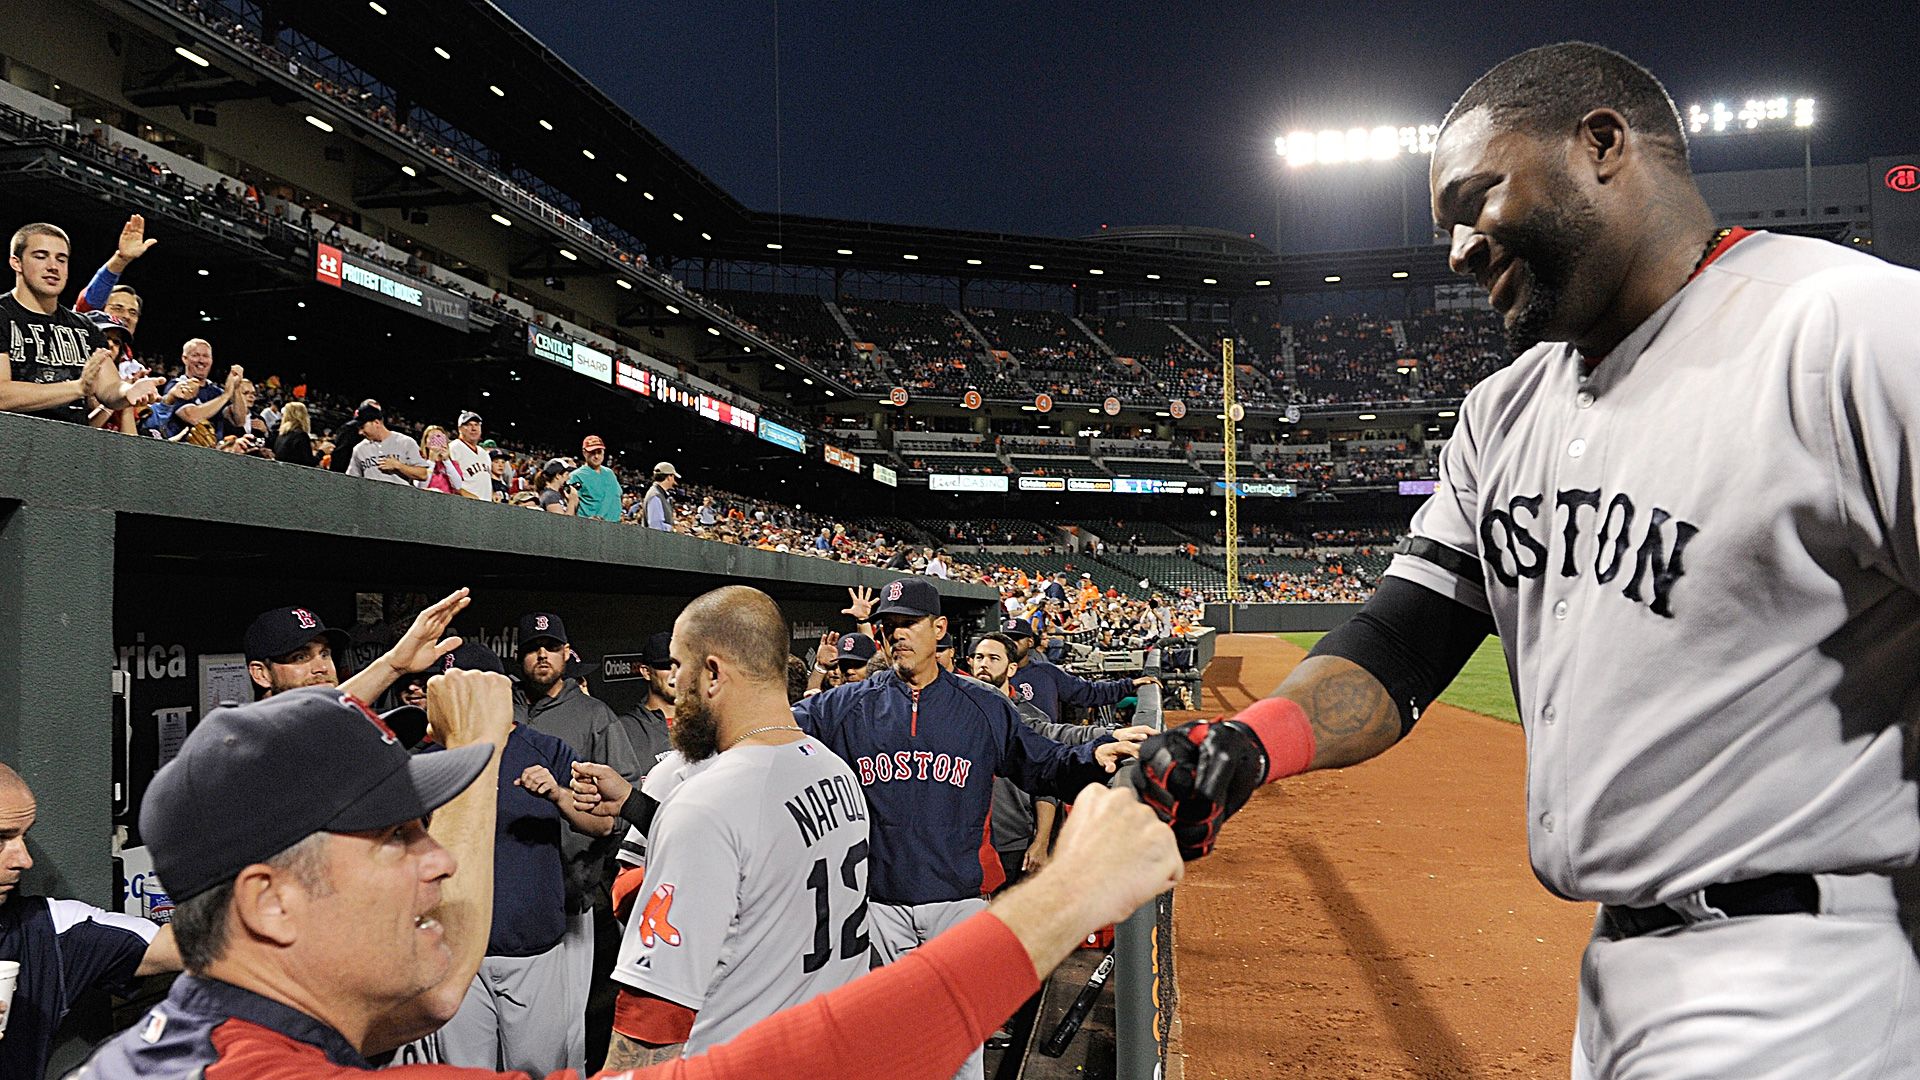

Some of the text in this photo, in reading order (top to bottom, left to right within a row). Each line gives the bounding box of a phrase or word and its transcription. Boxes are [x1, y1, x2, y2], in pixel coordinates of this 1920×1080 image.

[342, 262, 379, 291] PROTECT
[395, 282, 423, 307] HOUSE
[535, 332, 573, 359] CENTRIC
[577, 354, 608, 373] SHARP
[893, 391, 906, 402] 20
[969, 394, 977, 405] 5
[1040, 398, 1048, 408] 4
[932, 475, 1005, 489] Live! CASINO
[1242, 482, 1292, 497] DentaQuest
[887, 581, 903, 601] B
[292, 608, 316, 629] B
[534, 615, 549, 631] B
[1007, 619, 1018, 630] B
[843, 637, 855, 651] B
[605, 659, 640, 676] Orioles
[1019, 683, 1034, 701] B
[857, 750, 972, 788] BOSTON
[803, 838, 870, 974] 12
